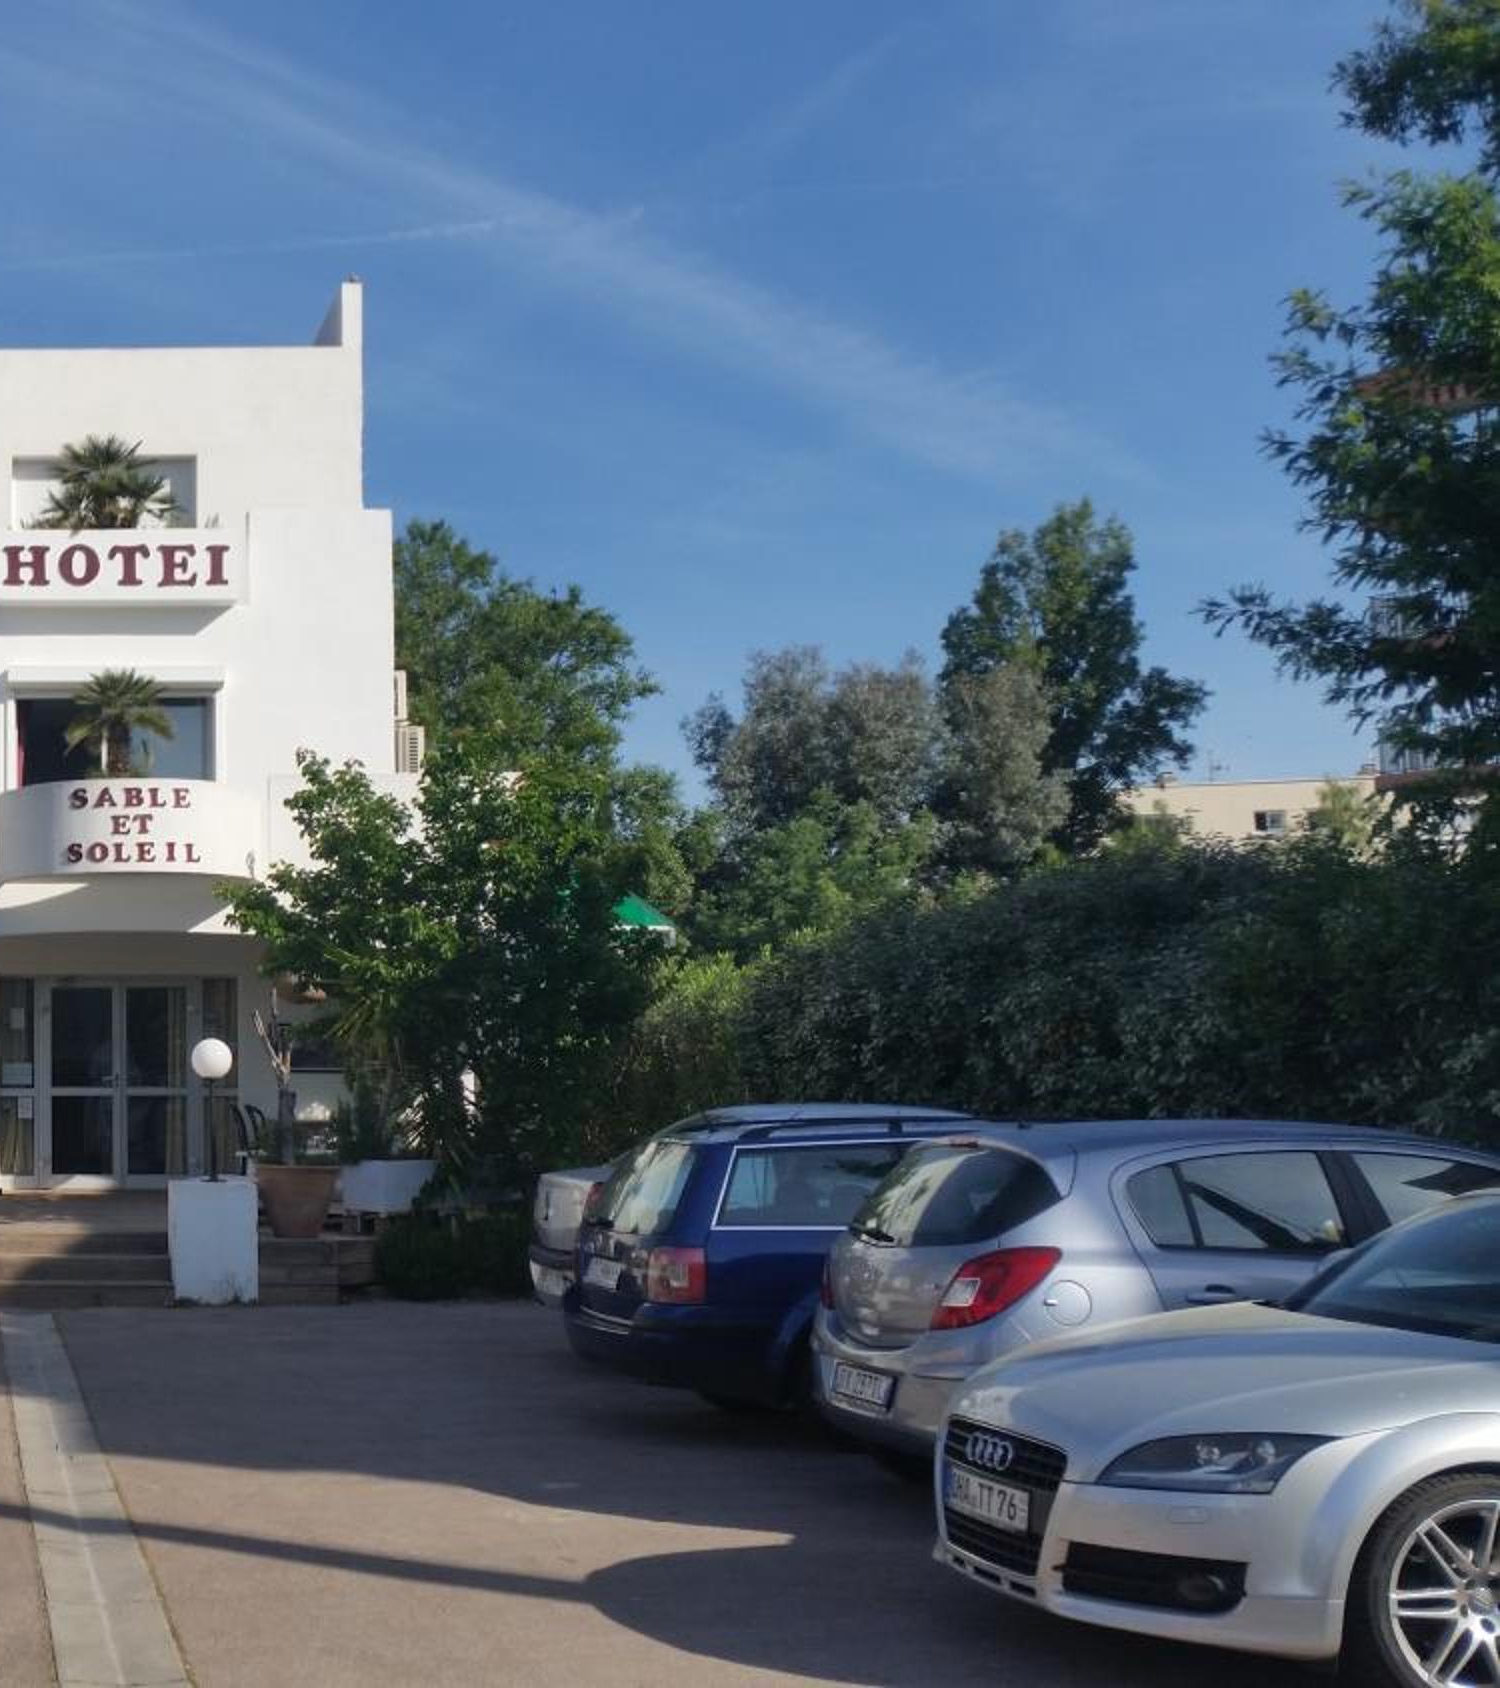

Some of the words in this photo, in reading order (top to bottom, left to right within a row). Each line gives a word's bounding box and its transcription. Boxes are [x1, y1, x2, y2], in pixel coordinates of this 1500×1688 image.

[69, 787, 191, 809] SABLE
[111, 814, 153, 835] ET
[67, 842, 201, 863] SOLEIL
[997, 1489, 1017, 1521] 76
